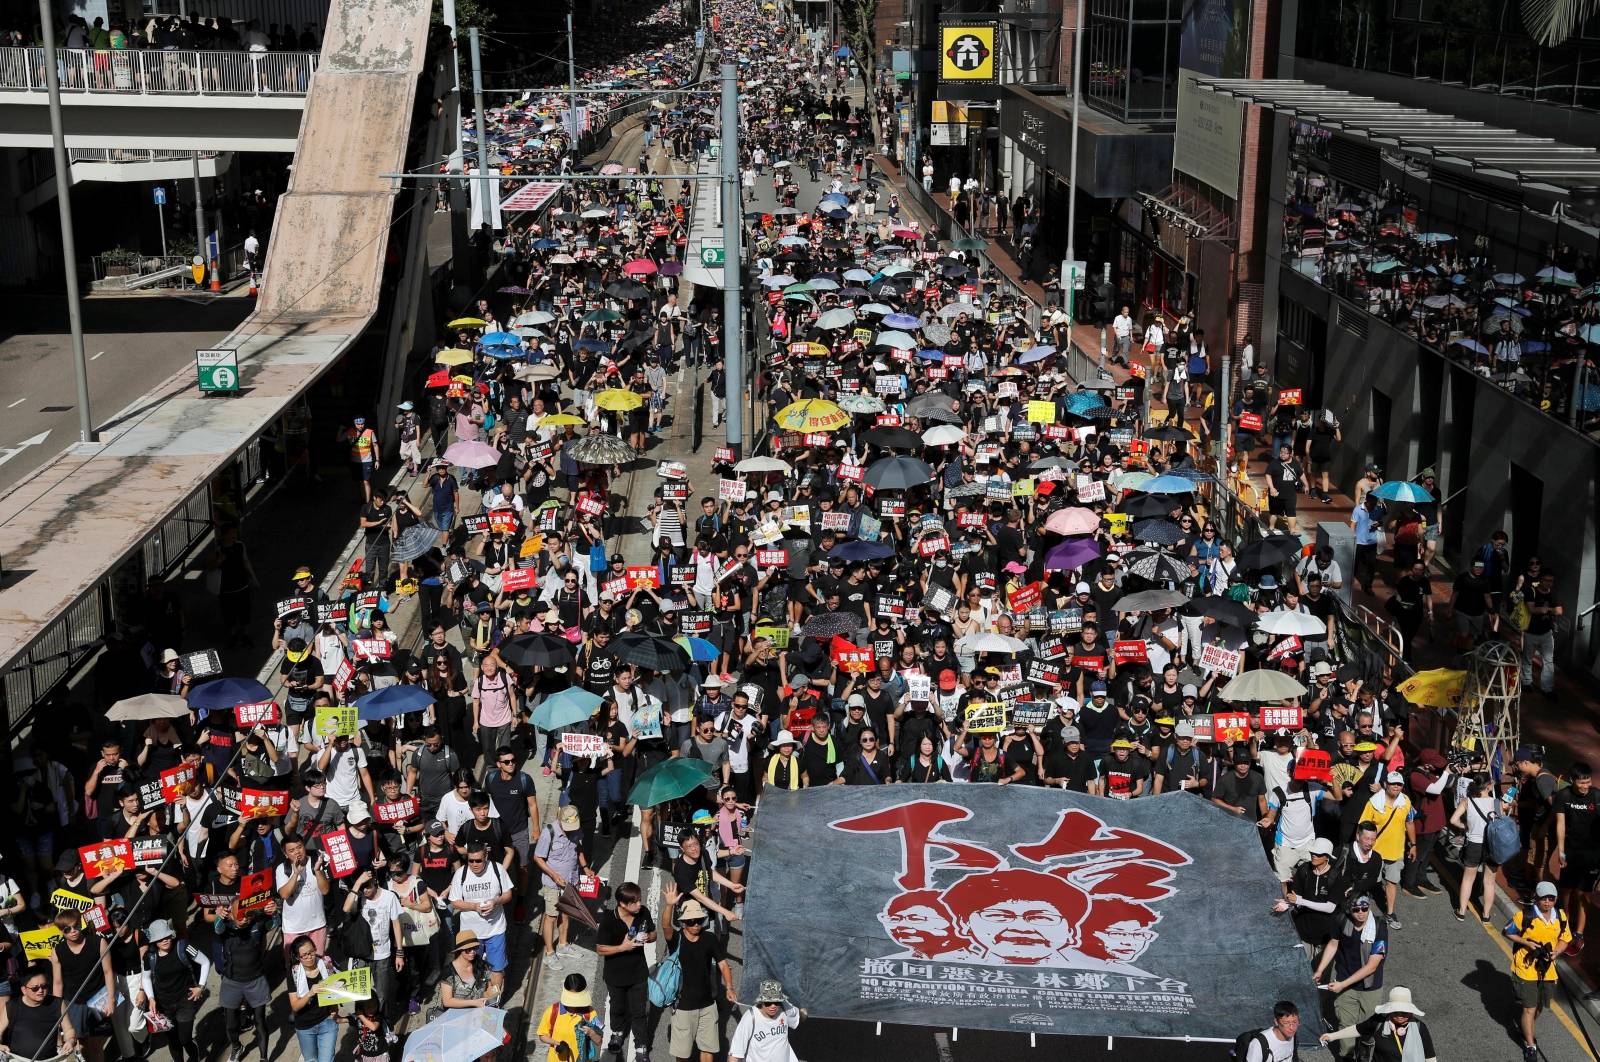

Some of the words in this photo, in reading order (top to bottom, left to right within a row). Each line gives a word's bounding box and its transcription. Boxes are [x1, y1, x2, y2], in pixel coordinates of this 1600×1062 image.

[839, 652, 870, 662] 賣港賊
[1205, 645, 1238, 662] 相信青年
[1203, 654, 1236, 671] 相信人民
[1264, 709, 1298, 717] 全面撤回
[1217, 718, 1247, 728] 賣港賊
[1264, 717, 1298, 726] 送中惡法
[564, 735, 602, 744] 相信青年
[564, 743, 602, 751] 相信人民
[164, 768, 195, 786] 賣港賊
[244, 795, 284, 806] 賣港賊
[378, 800, 413, 812] 全面撤回
[250, 805, 280, 817] 下台
[380, 807, 415, 821] 送中惡法
[215, 815, 233, 825] NIKE
[84, 844, 128, 863] 賣港賊
[828, 798, 1194, 900] 下台
[93, 856, 126, 873] 下台
[53, 890, 78, 909] STAND
[79, 900, 92, 913] UP
[859, 957, 1016, 986] 撤回惡法
[1032, 972, 1188, 994] 林鄭下台
[861, 978, 878, 986] NO
[882, 979, 965, 992] EXTRADITION
[988, 986, 1028, 994] CHINA
[1038, 990, 1084, 999] CARRIE
[1152, 995, 1194, 1004] DOWN
